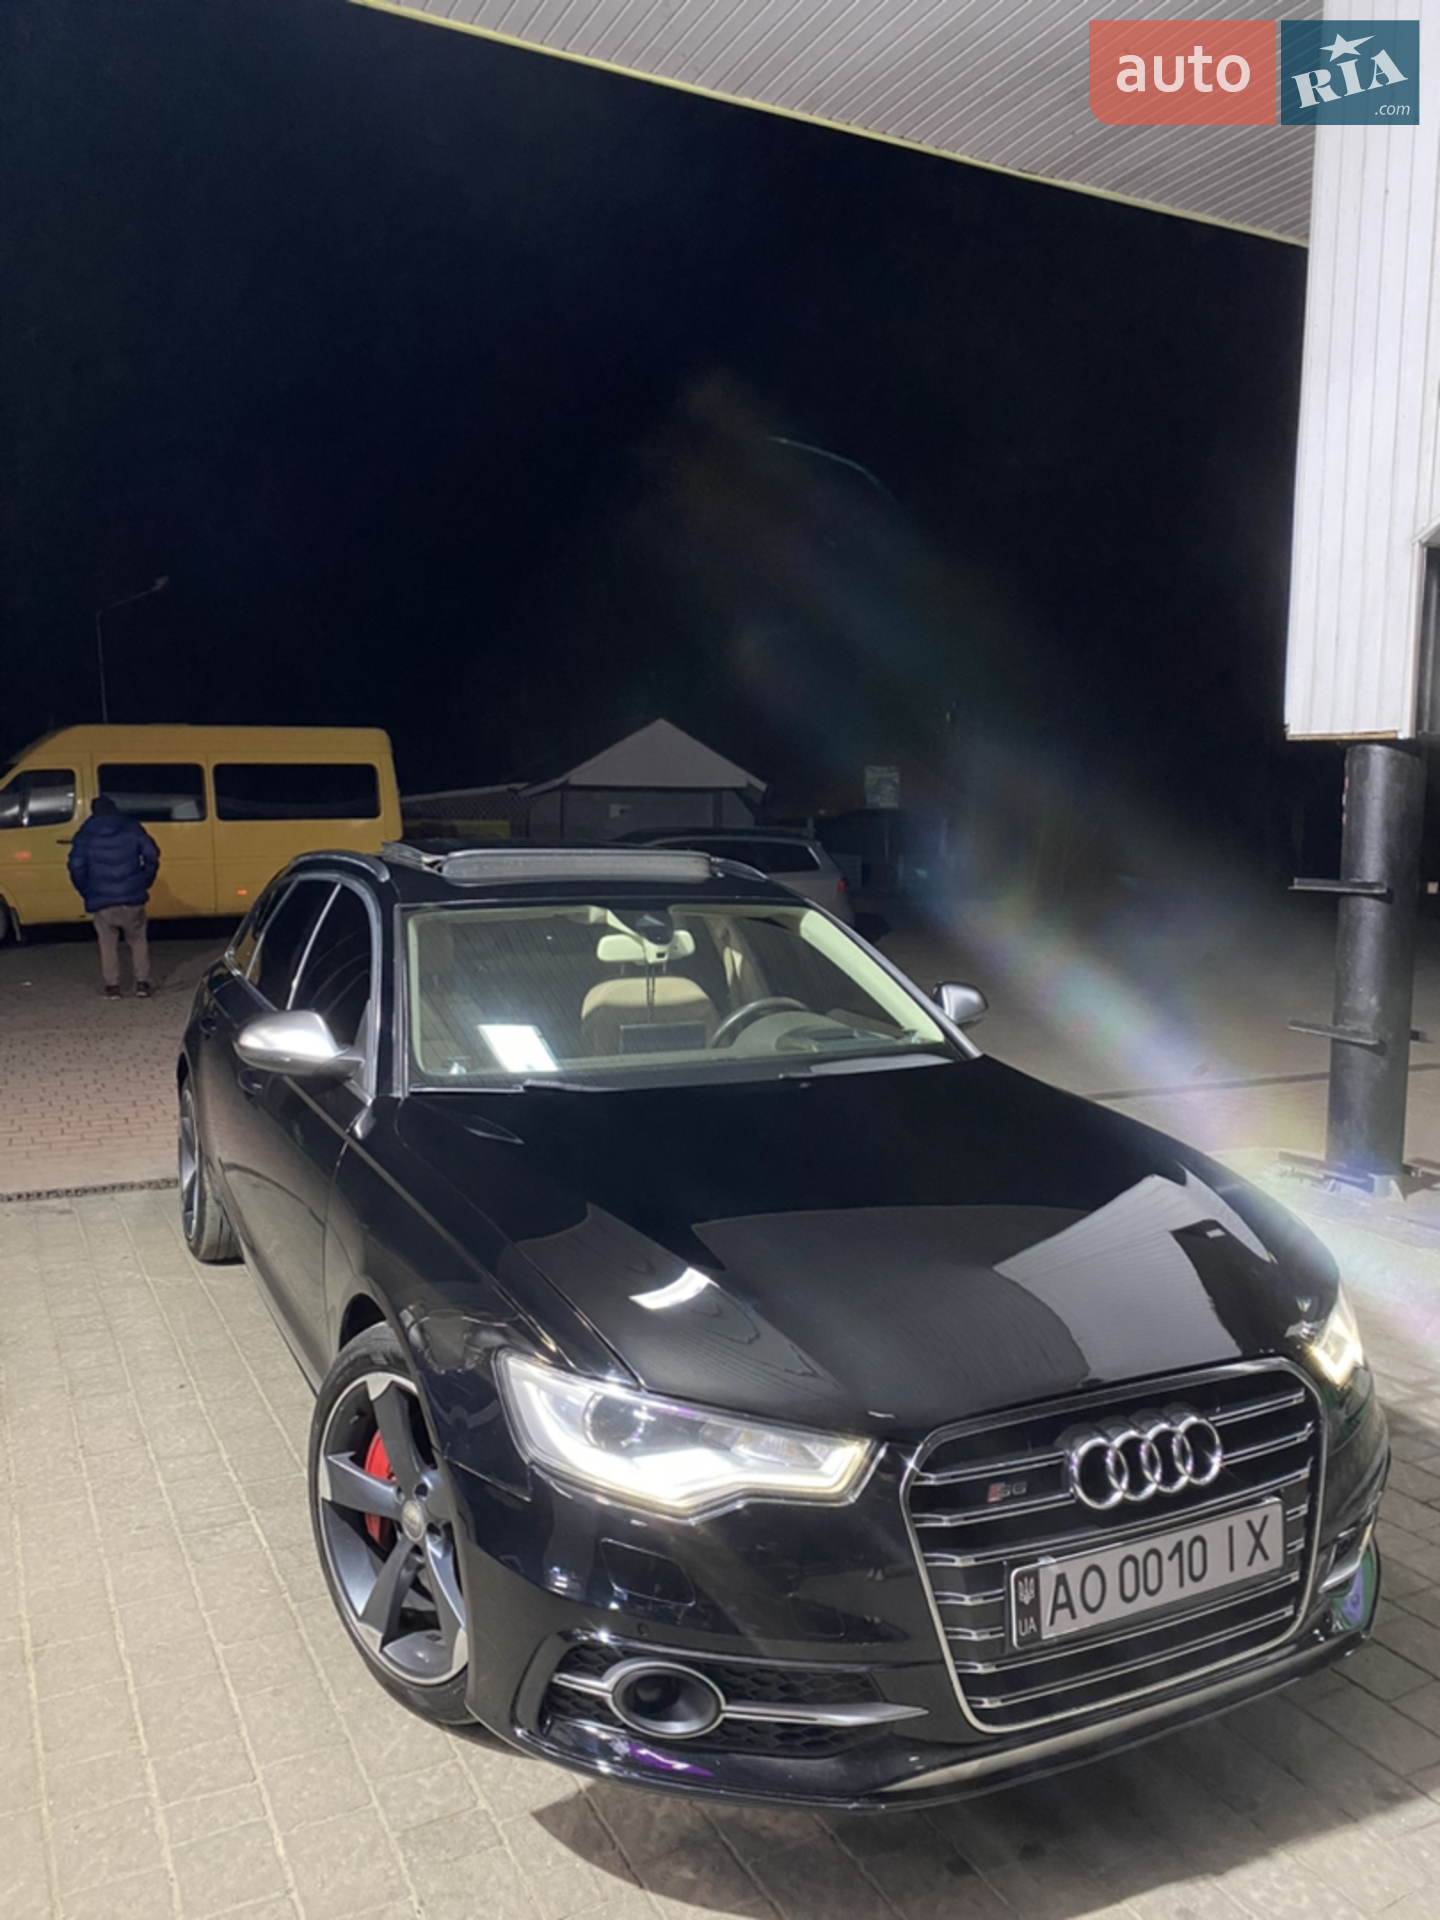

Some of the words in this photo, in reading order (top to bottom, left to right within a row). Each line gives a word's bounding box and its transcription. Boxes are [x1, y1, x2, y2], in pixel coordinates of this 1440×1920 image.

[1048, 1563, 1107, 1627] AO
[1118, 1534, 1208, 1604] 0010
[1018, 1616, 1037, 1637] UA
